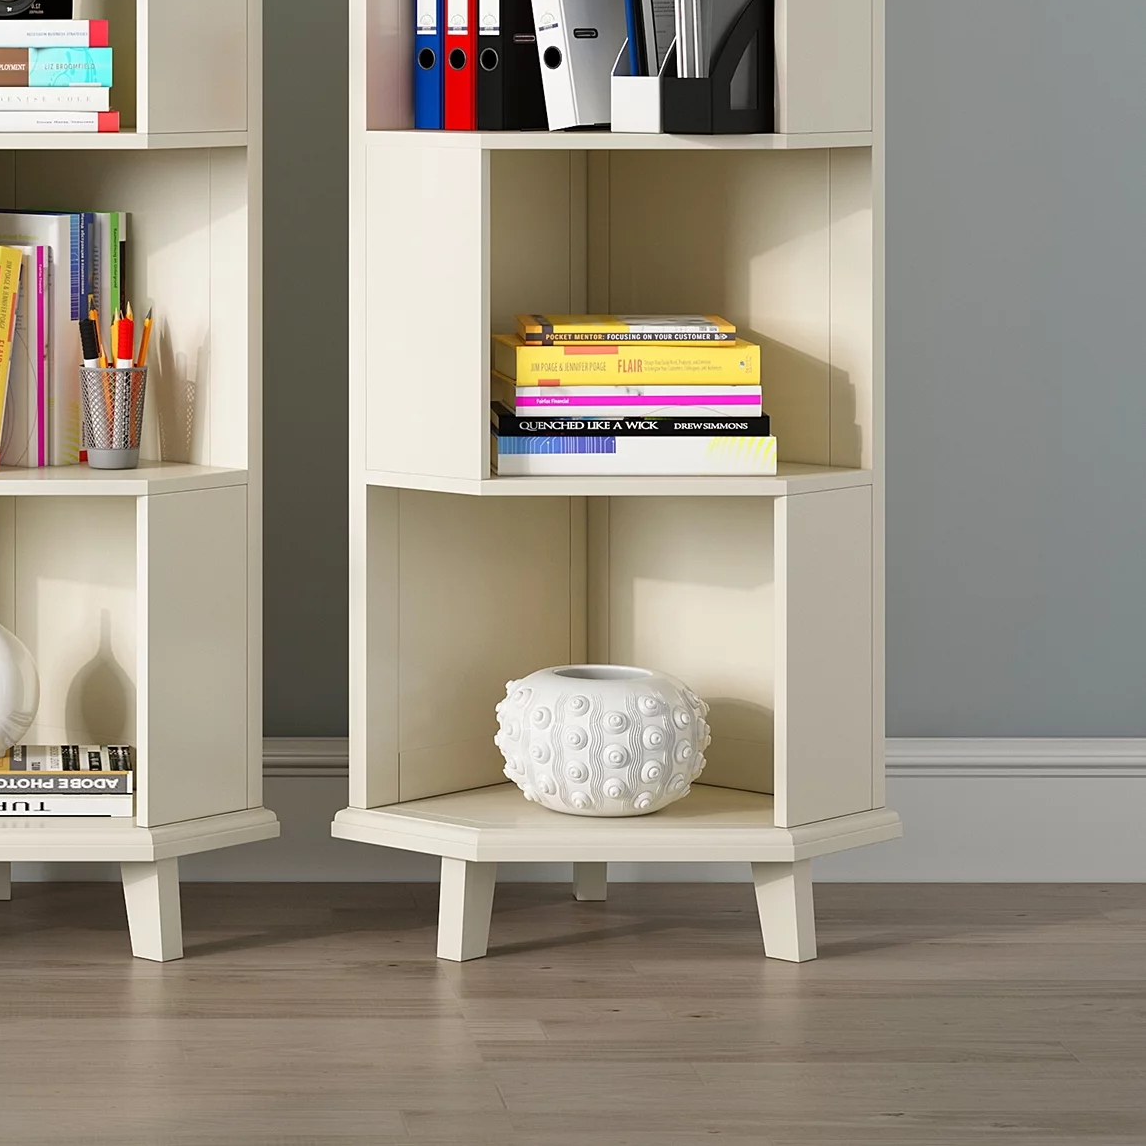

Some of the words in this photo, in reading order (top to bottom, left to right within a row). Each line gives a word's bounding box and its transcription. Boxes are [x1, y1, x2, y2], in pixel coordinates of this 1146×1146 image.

[3, 269, 11, 286] POAGE
[0, 290, 8, 313] JENNIFER
[546, 333, 573, 341] POCKET
[607, 333, 641, 341] FOCUSING
[531, 362, 541, 372] JIM
[541, 362, 558, 372] POAGE
[559, 362, 563, 372] &
[564, 362, 589, 372] JENNIFER
[590, 362, 606, 372] POAGE
[617, 359, 643, 373] FLAIR
[519, 421, 585, 431] QUENCHED
[587, 421, 610, 430] LIKE
[613, 421, 623, 430] A
[625, 421, 659, 430] WICK
[58, 778, 119, 789] ADOBE
